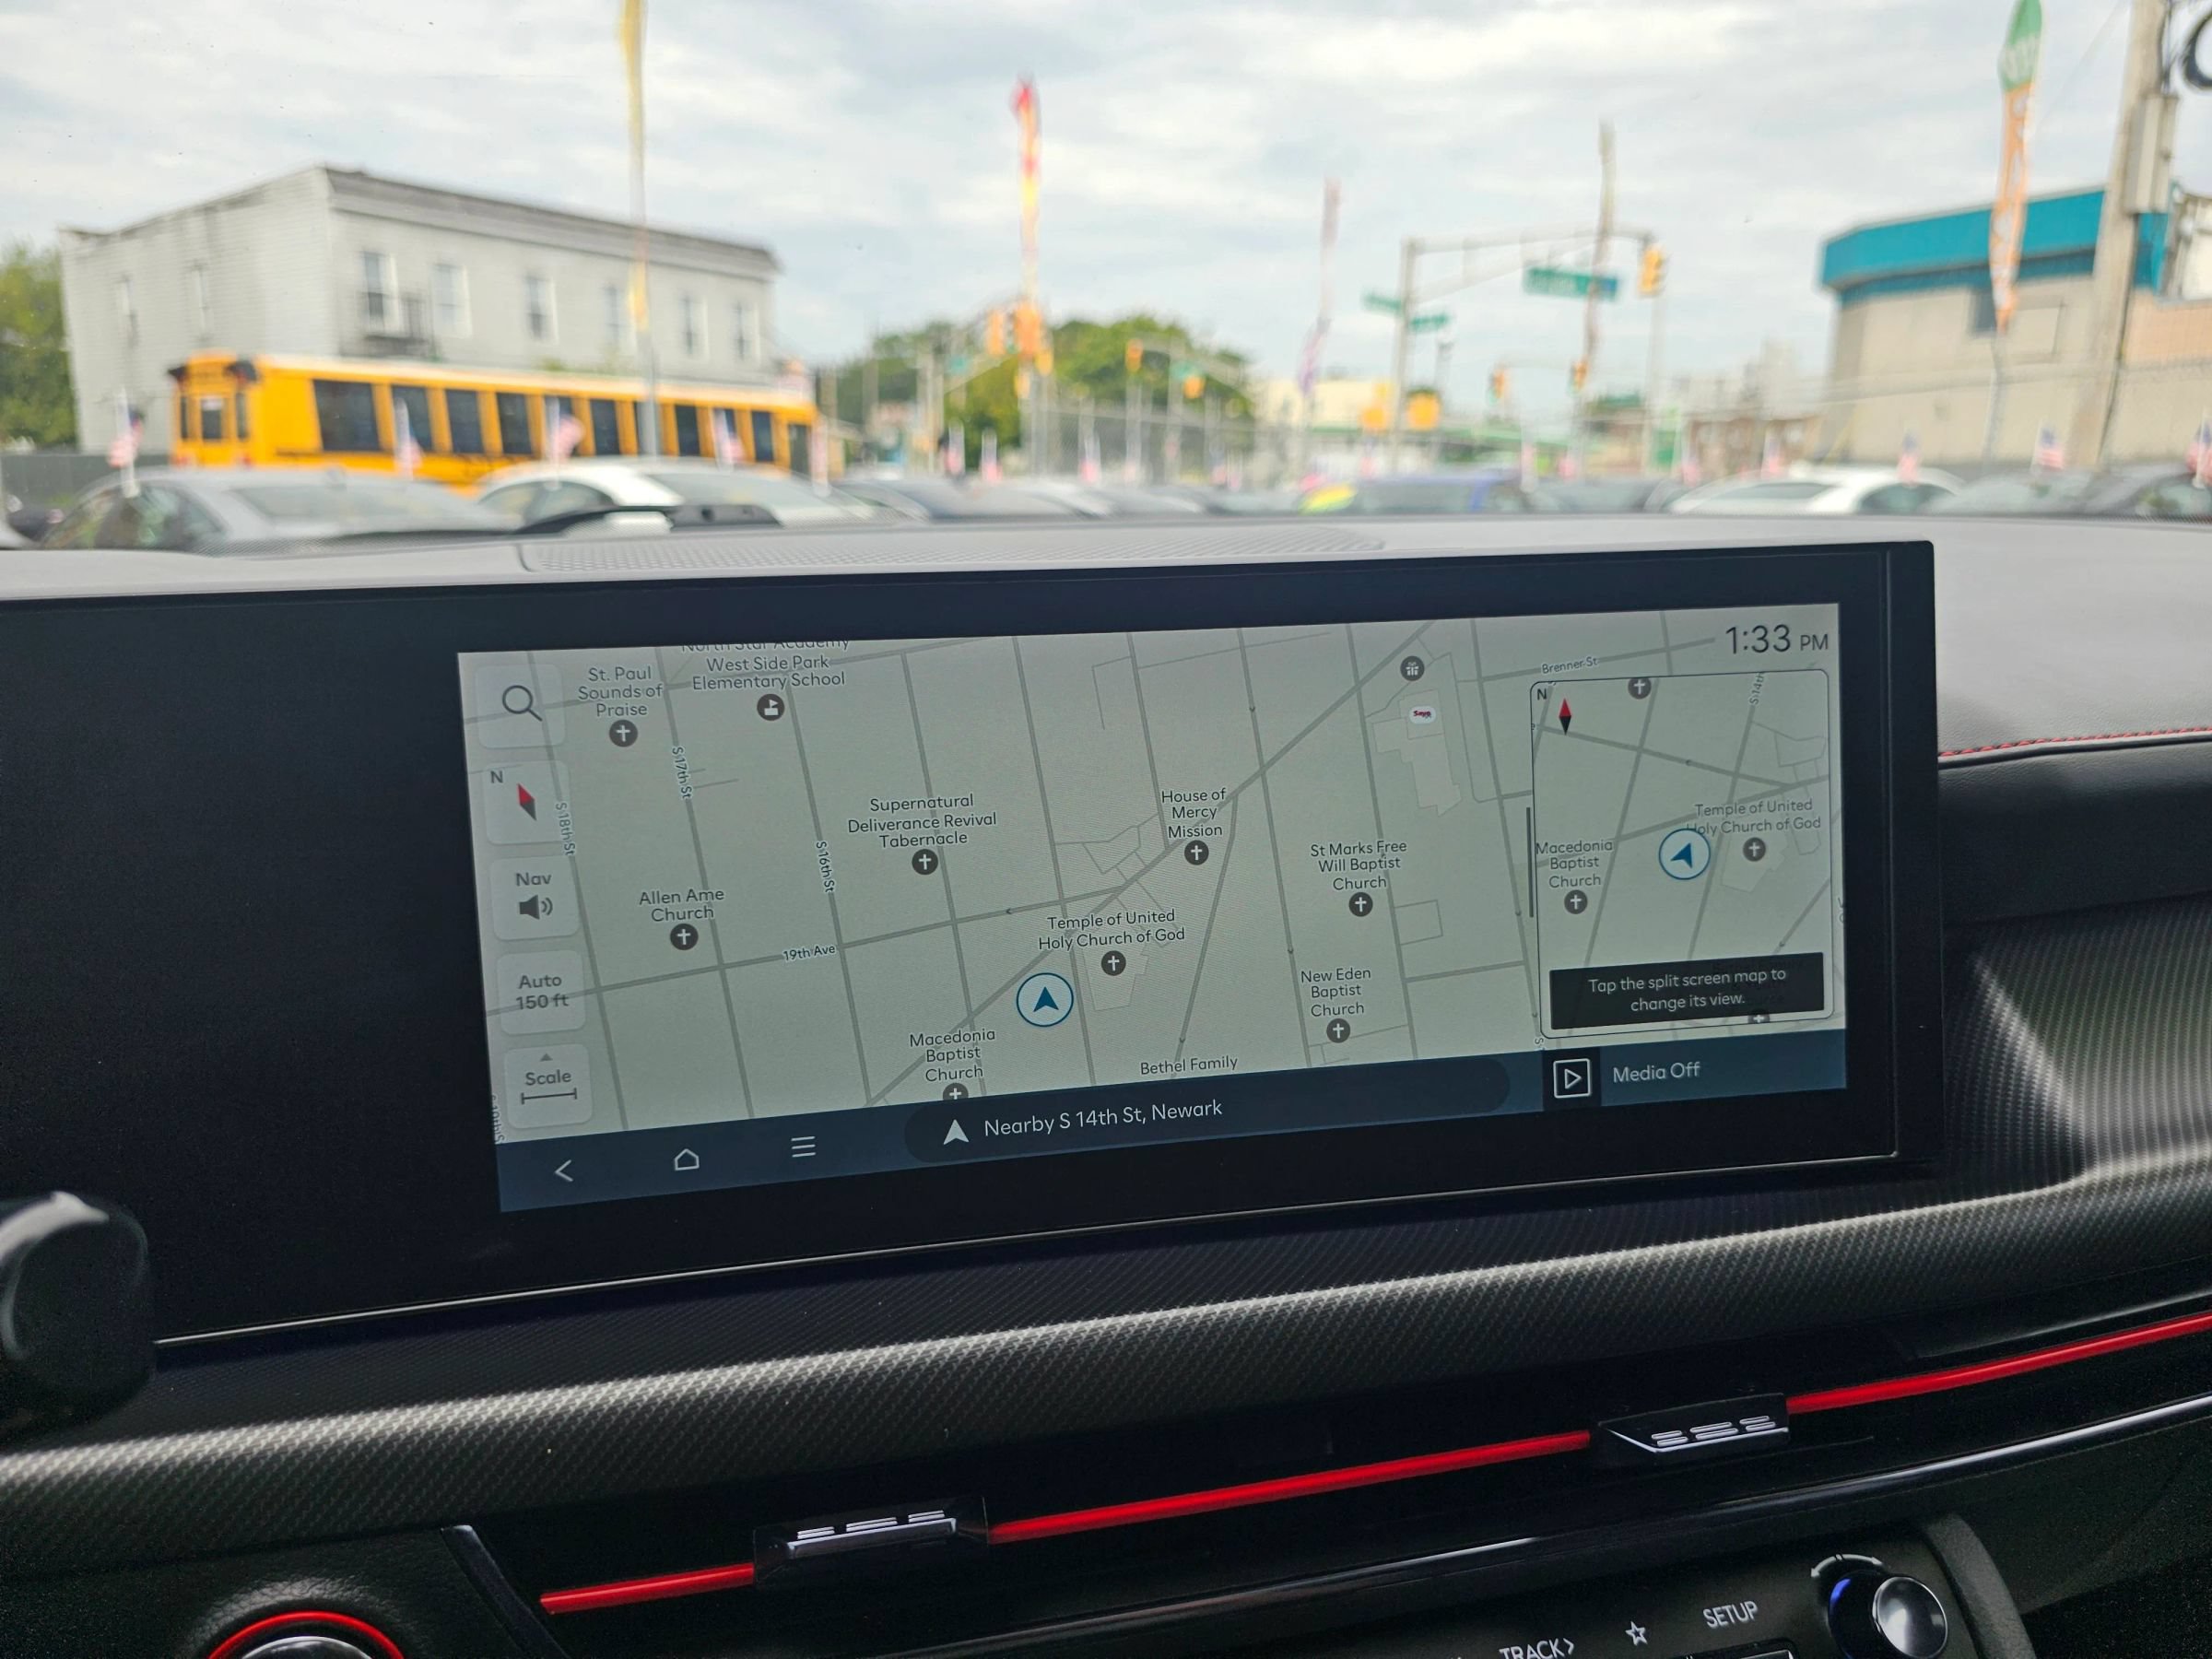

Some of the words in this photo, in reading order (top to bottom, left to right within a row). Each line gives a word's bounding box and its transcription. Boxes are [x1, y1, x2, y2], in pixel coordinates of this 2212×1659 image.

[1725, 624, 1792, 654] 1:33
[1800, 633, 1830, 652] PM
[706, 657, 749, 672] West
[753, 656, 788, 671] Side
[793, 654, 830, 669] Park
[1541, 662, 1586, 674] Brenner
[1587, 656, 1598, 667] St
[588, 668, 611, 682] St.
[615, 666, 652, 680] Paul
[693, 676, 786, 690] Elementary
[791, 671, 845, 687] School
[578, 686, 641, 700] Sounds
[645, 683, 663, 698] of
[1536, 688, 1547, 700] N
[596, 702, 648, 717] Praise
[672, 747, 684, 755] S
[490, 771, 503, 783] N
[675, 757, 689, 784] 17th
[680, 786, 692, 799] St
[1160, 790, 1206, 804] House
[1210, 787, 1227, 801] of
[555, 802, 568, 810] S
[870, 794, 974, 813] Supernatural
[1695, 804, 1746, 818] Temple
[1748, 801, 1764, 814] of
[1767, 798, 1813, 813] United
[1171, 806, 1218, 820] Mercy
[558, 812, 573, 841] 18th
[848, 817, 940, 833] Deliverance
[944, 812, 996, 828] Revival
[1721, 818, 1772, 834] Church
[1775, 818, 1790, 830] of
[1793, 817, 1821, 830] God
[1168, 824, 1223, 840] Mission
[564, 842, 576, 856] St
[816, 841, 828, 849] S
[878, 832, 968, 850] Tabernacle
[1310, 844, 1324, 856] St
[1329, 842, 1372, 856] Marks
[1376, 841, 1407, 853] Free
[1536, 841, 1613, 856] Macedonia
[818, 851, 832, 878] 16th
[1318, 857, 1346, 873] Will
[1350, 856, 1401, 872] Baptist
[1550, 856, 1599, 872] Baptist
[515, 872, 552, 887] Nav
[824, 879, 835, 893] St
[1333, 875, 1387, 890] Church
[1548, 874, 1602, 889] Church
[639, 890, 682, 906] Allen
[686, 888, 725, 903] Ame
[651, 904, 714, 922] Church
[1047, 915, 1103, 931] Temple
[1106, 913, 1123, 927] of
[1125, 909, 1175, 925] United
[1039, 935, 1073, 951] Holy
[1077, 930, 1132, 947] Church
[1135, 930, 1152, 944] of
[1155, 927, 1185, 943] God
[782, 948, 811, 961] 19th
[814, 944, 836, 957] Ave
[518, 974, 562, 990] Auto
[1300, 970, 1333, 983] New
[1336, 967, 1371, 981] Eden
[1588, 978, 1617, 994] Tap
[1620, 976, 1644, 990] the
[1648, 974, 1679, 990] split
[1682, 973, 1731, 987] screen
[1734, 971, 1768, 984] map
[1771, 968, 1786, 981] to
[1311, 984, 1362, 999] Baptist
[516, 995, 549, 1010] 150
[553, 993, 569, 1007] ft
[1311, 1002, 1365, 1018] Church
[1630, 997, 1686, 1013] change
[1689, 994, 1707, 1007] its
[1710, 992, 1746, 1006] view.
[910, 1030, 995, 1047] Macedonia
[926, 1046, 981, 1063] Baptist
[925, 1065, 983, 1082] Church
[1140, 1060, 1187, 1075] Bethel
[1190, 1055, 1238, 1073] Family
[1613, 1065, 1666, 1083] Media
[1670, 1062, 1701, 1078] Off
[524, 1070, 572, 1086] Scale
[984, 1117, 1054, 1137] Nearby
[1060, 1114, 1071, 1130] S
[1076, 1109, 1118, 1127] 14th
[1123, 1107, 1147, 1125] St,
[1151, 1099, 1223, 1121] Newark
[1703, 1600, 1759, 1629] SETUP
